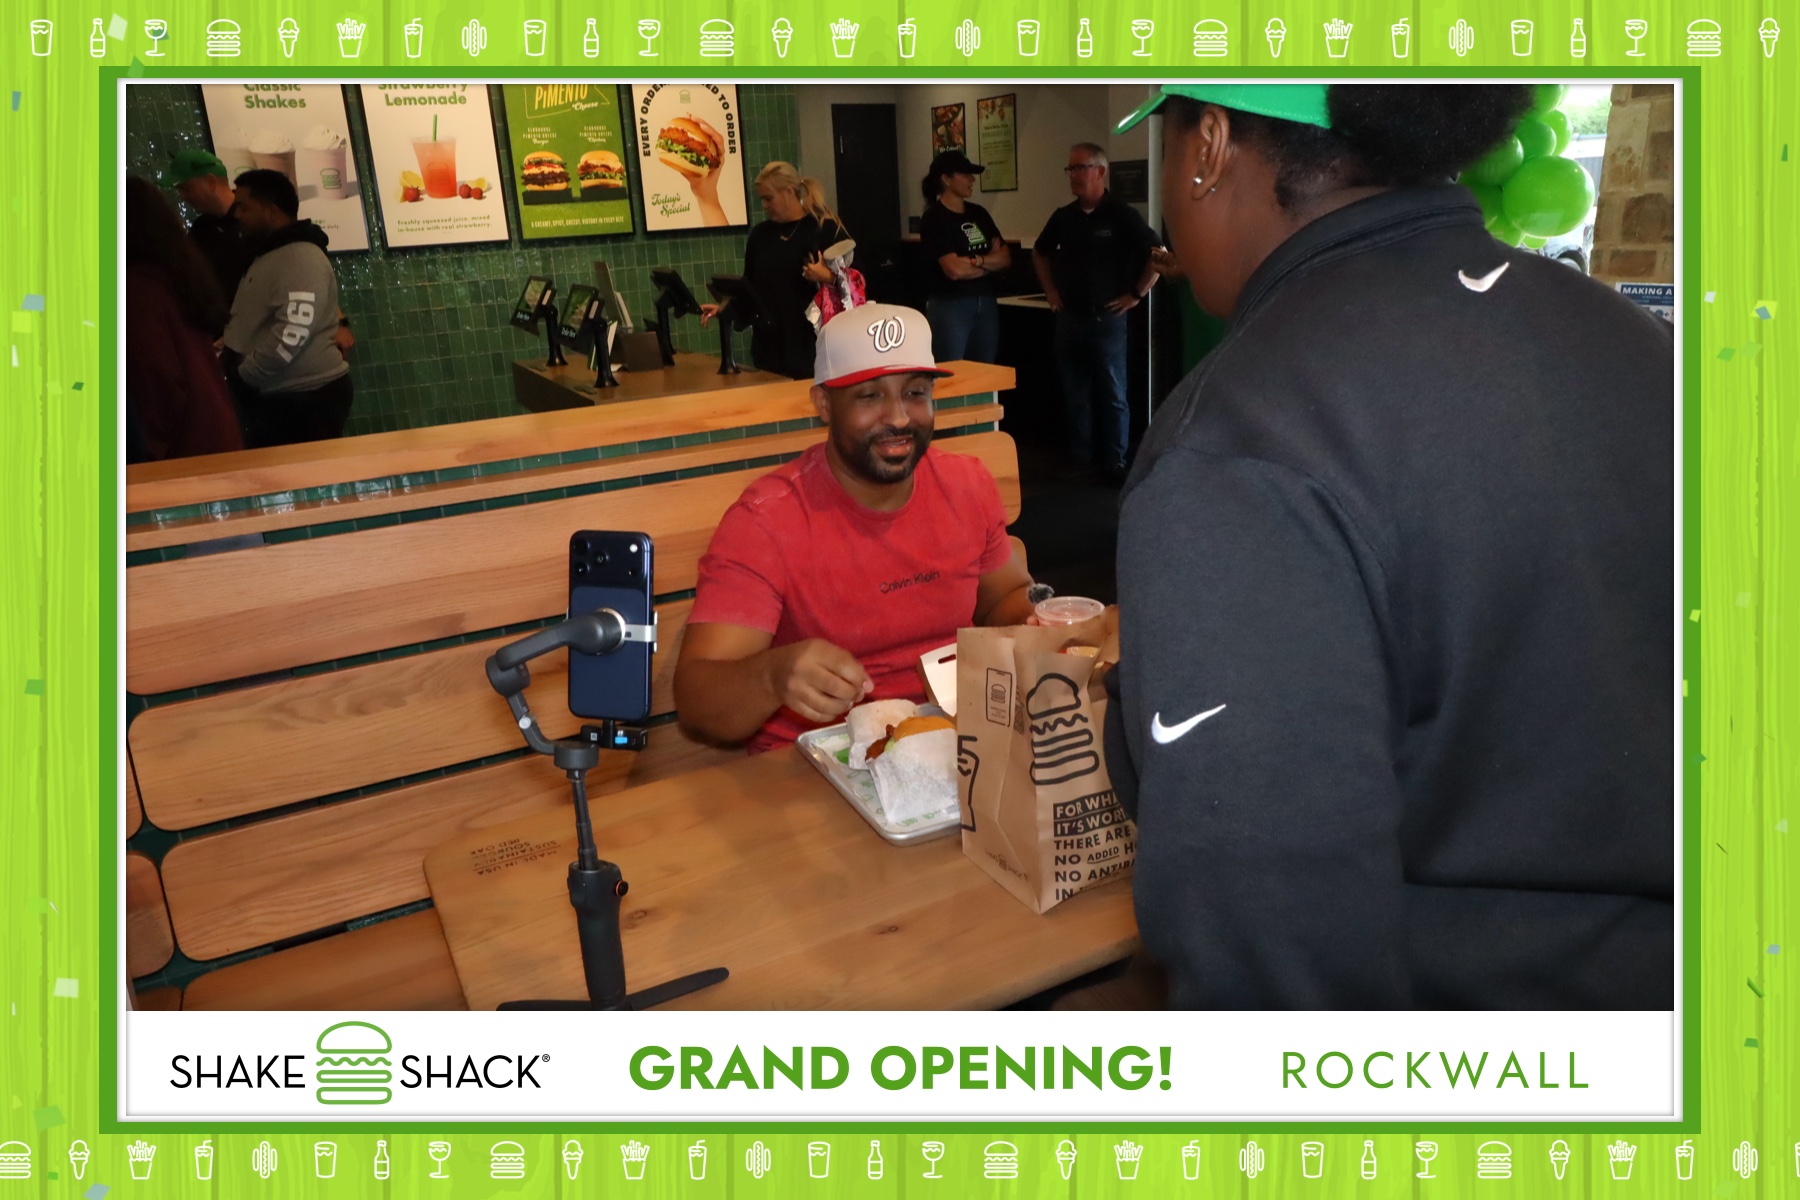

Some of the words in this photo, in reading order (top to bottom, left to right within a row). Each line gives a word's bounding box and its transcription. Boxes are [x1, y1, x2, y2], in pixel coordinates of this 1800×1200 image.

[244, 93, 306, 109] Shakes
[385, 92, 467, 106] Lemonade
[572, 102, 599, 111] Cheese
[640, 84, 670, 115] ORDE
[718, 94, 730, 110] TO
[725, 113, 736, 154] ORDER
[640, 117, 651, 157] EVERY
[651, 193, 681, 206] Today's
[660, 203, 691, 218] Special
[422, 218, 452, 226] squeezed
[1622, 287, 1663, 296] MAKING
[867, 315, 906, 353] W
[880, 578, 912, 594] Calvin
[914, 570, 941, 584] Klein
[1056, 802, 1083, 819] FOR
[1085, 791, 1119, 811] WHA
[1056, 819, 1084, 835] IT'S
[1086, 807, 1128, 829] WORT
[1054, 834, 1101, 850] THERE
[1106, 825, 1131, 843] ARE
[469, 845, 495, 856] OAK
[524, 850, 557, 863] MADE
[1054, 854, 1081, 866] NO
[1087, 846, 1119, 862] ADDED
[1124, 841, 1137, 855] H
[477, 866, 501, 875] USA
[1054, 870, 1081, 883] NO
[1056, 888, 1074, 901] IN
